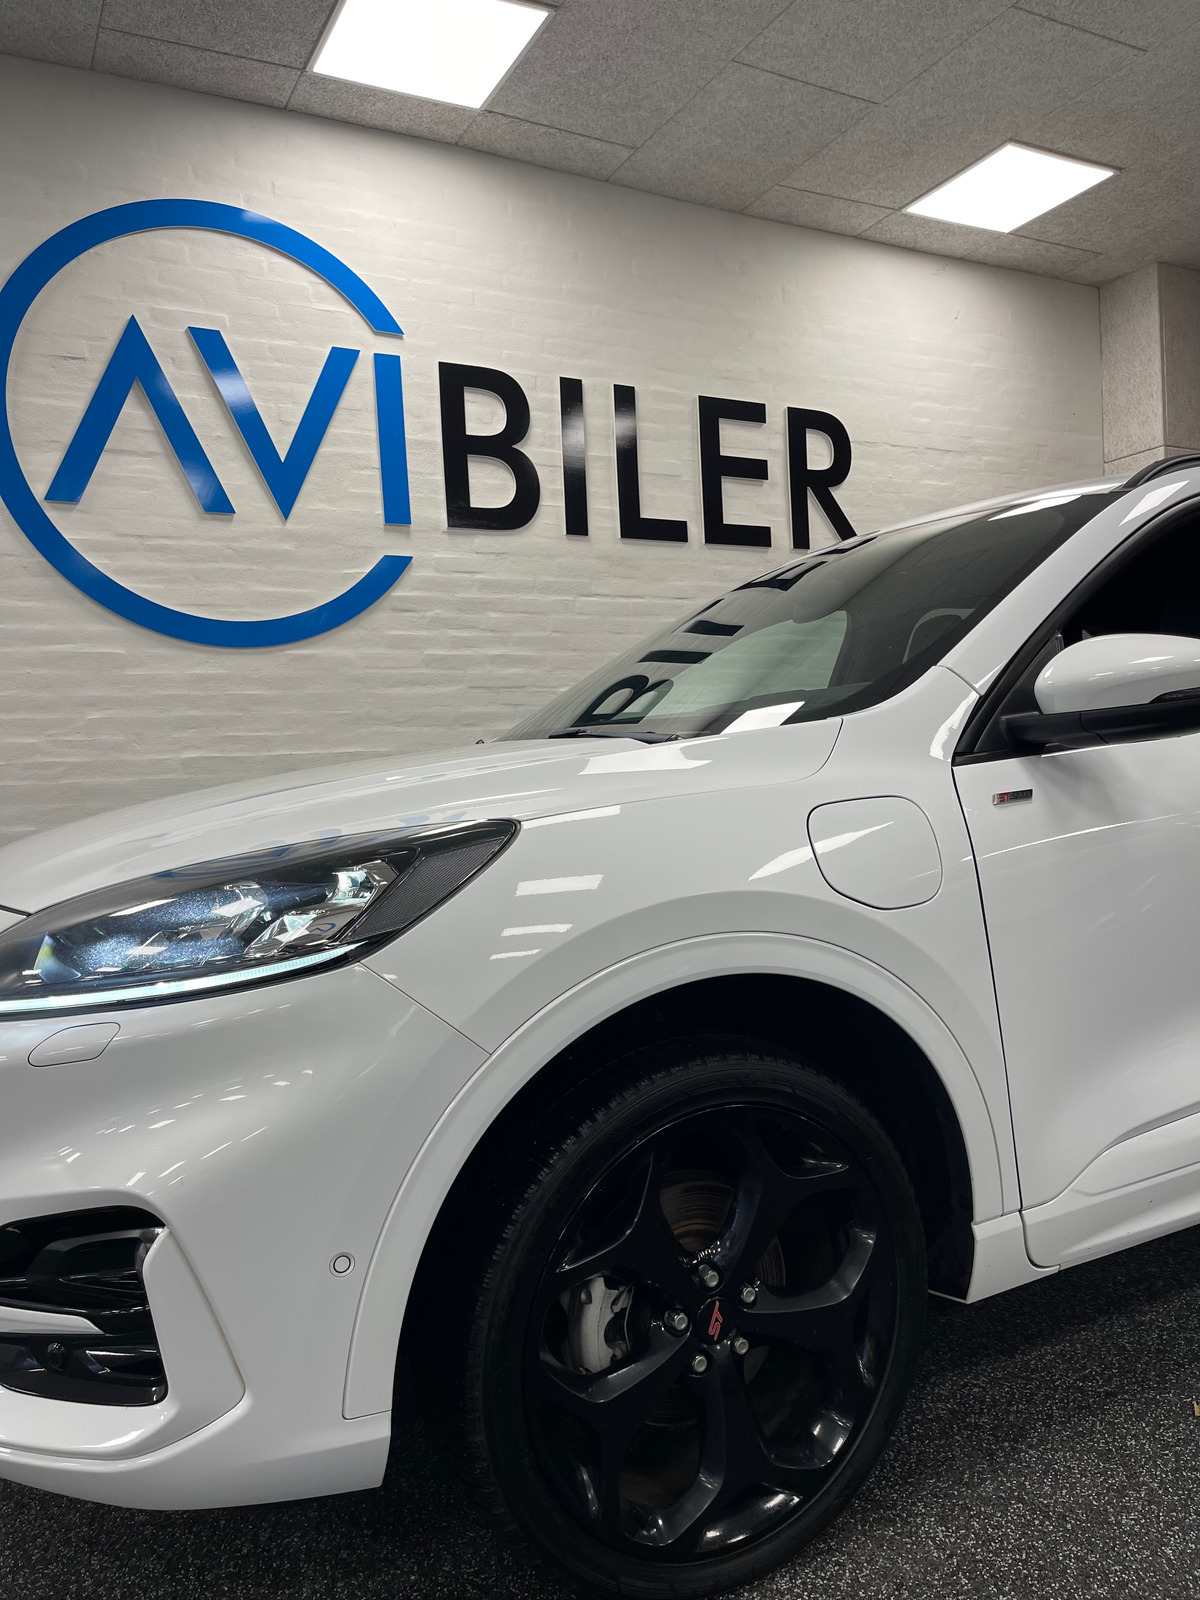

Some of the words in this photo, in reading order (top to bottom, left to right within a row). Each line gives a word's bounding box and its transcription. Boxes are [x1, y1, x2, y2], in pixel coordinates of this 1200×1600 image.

[45, 315, 412, 526] AVI
[438, 361, 858, 550] BILER
[708, 1300, 723, 1341] ST
